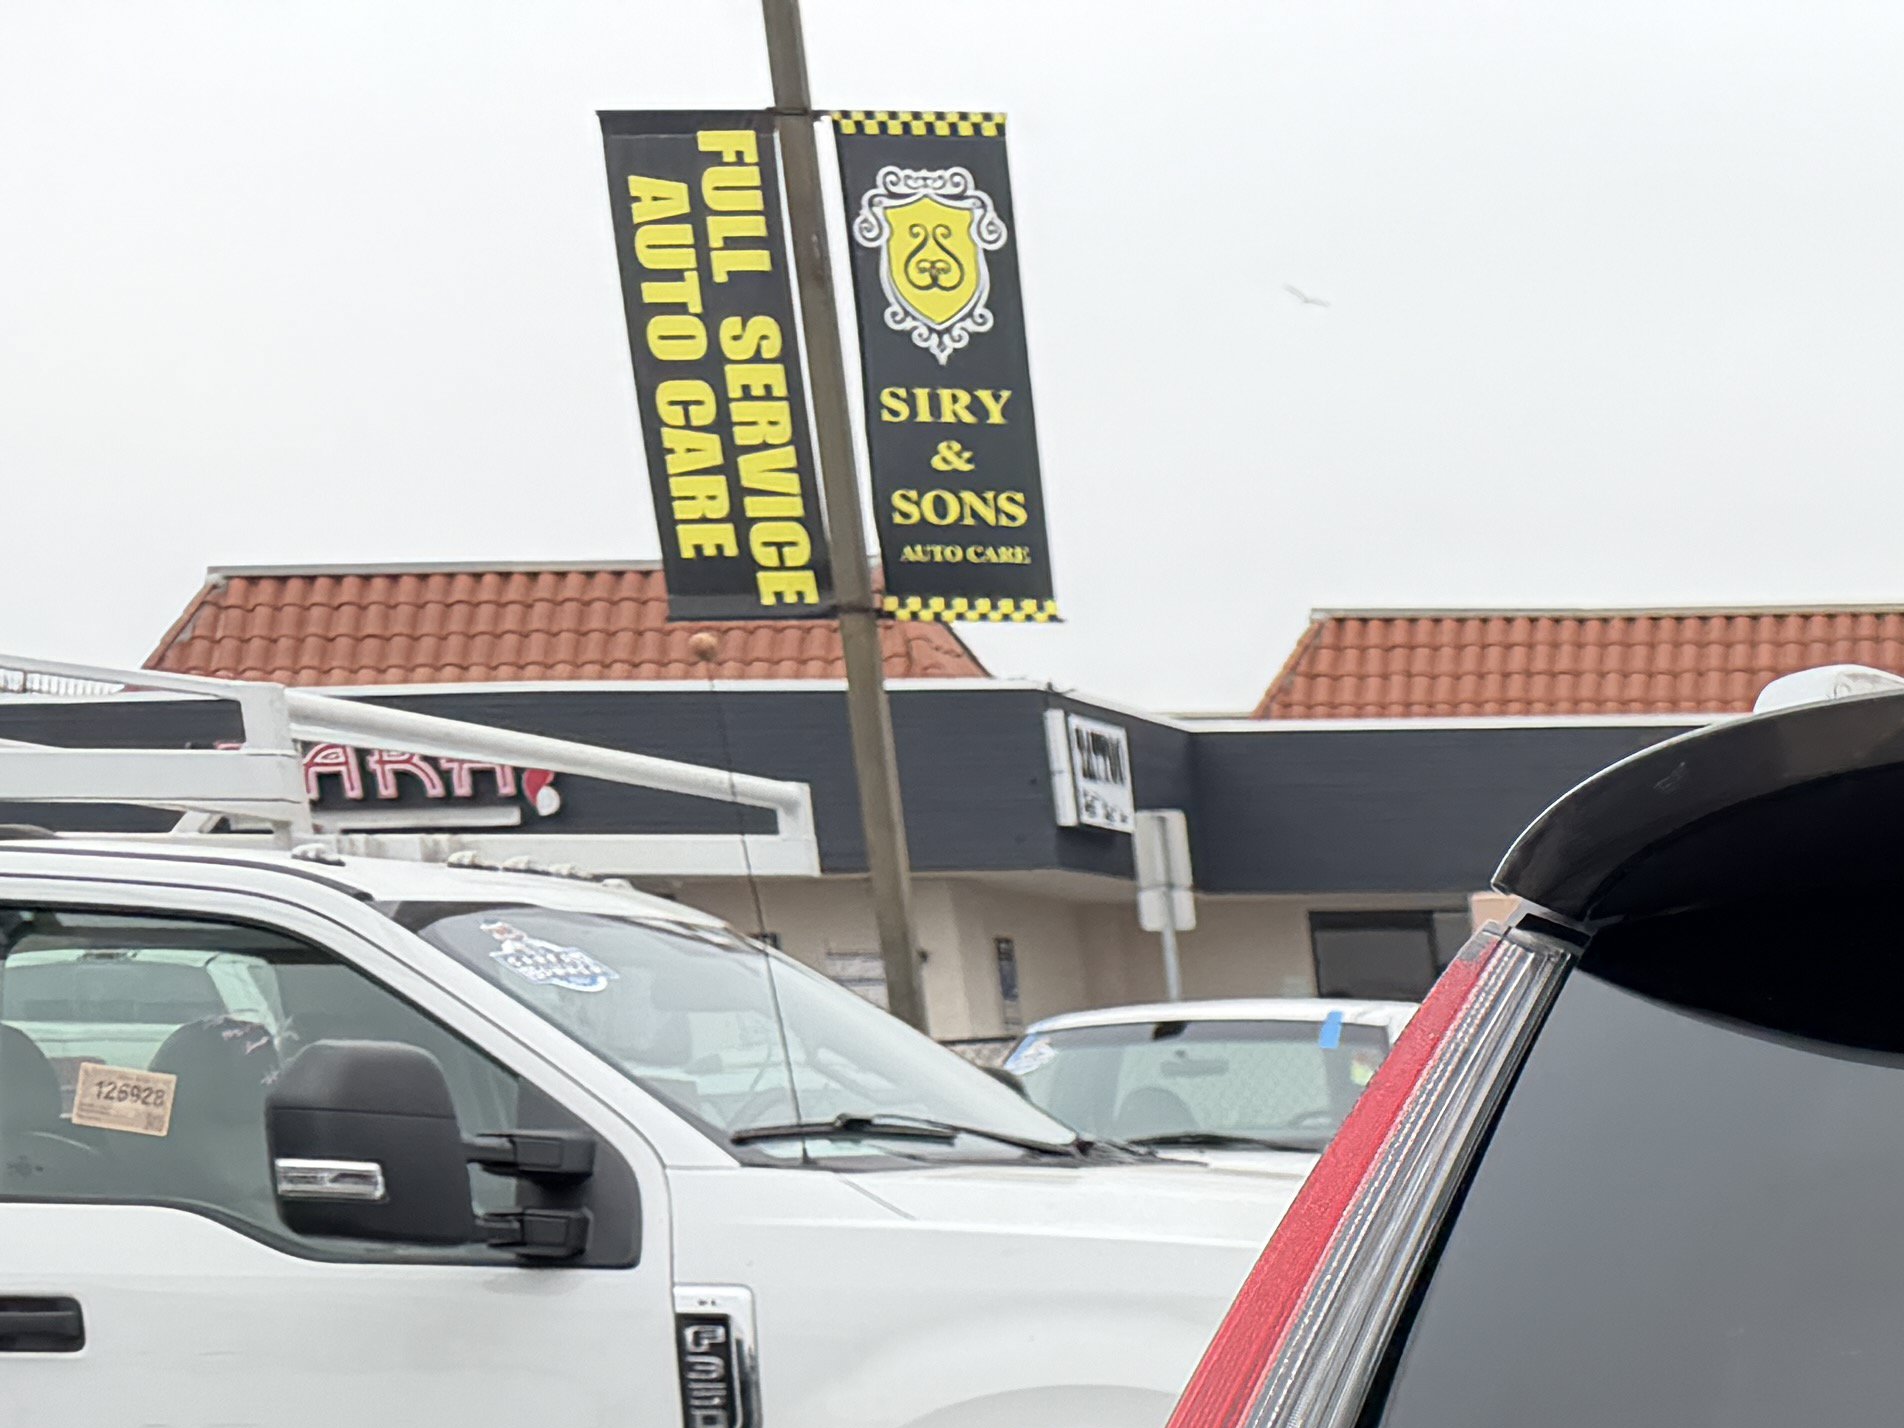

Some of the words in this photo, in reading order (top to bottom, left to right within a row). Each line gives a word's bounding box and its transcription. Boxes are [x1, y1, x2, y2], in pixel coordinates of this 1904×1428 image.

[697, 129, 772, 284] FULL
[627, 175, 708, 361] AUTO
[880, 386, 1012, 425] SIRY
[655, 379, 739, 559] CARE
[718, 315, 819, 606] SERVICE
[931, 439, 976, 472] &
[891, 488, 1028, 528] SONS
[901, 543, 964, 563] AUTO
[965, 544, 1032, 565] CARE
